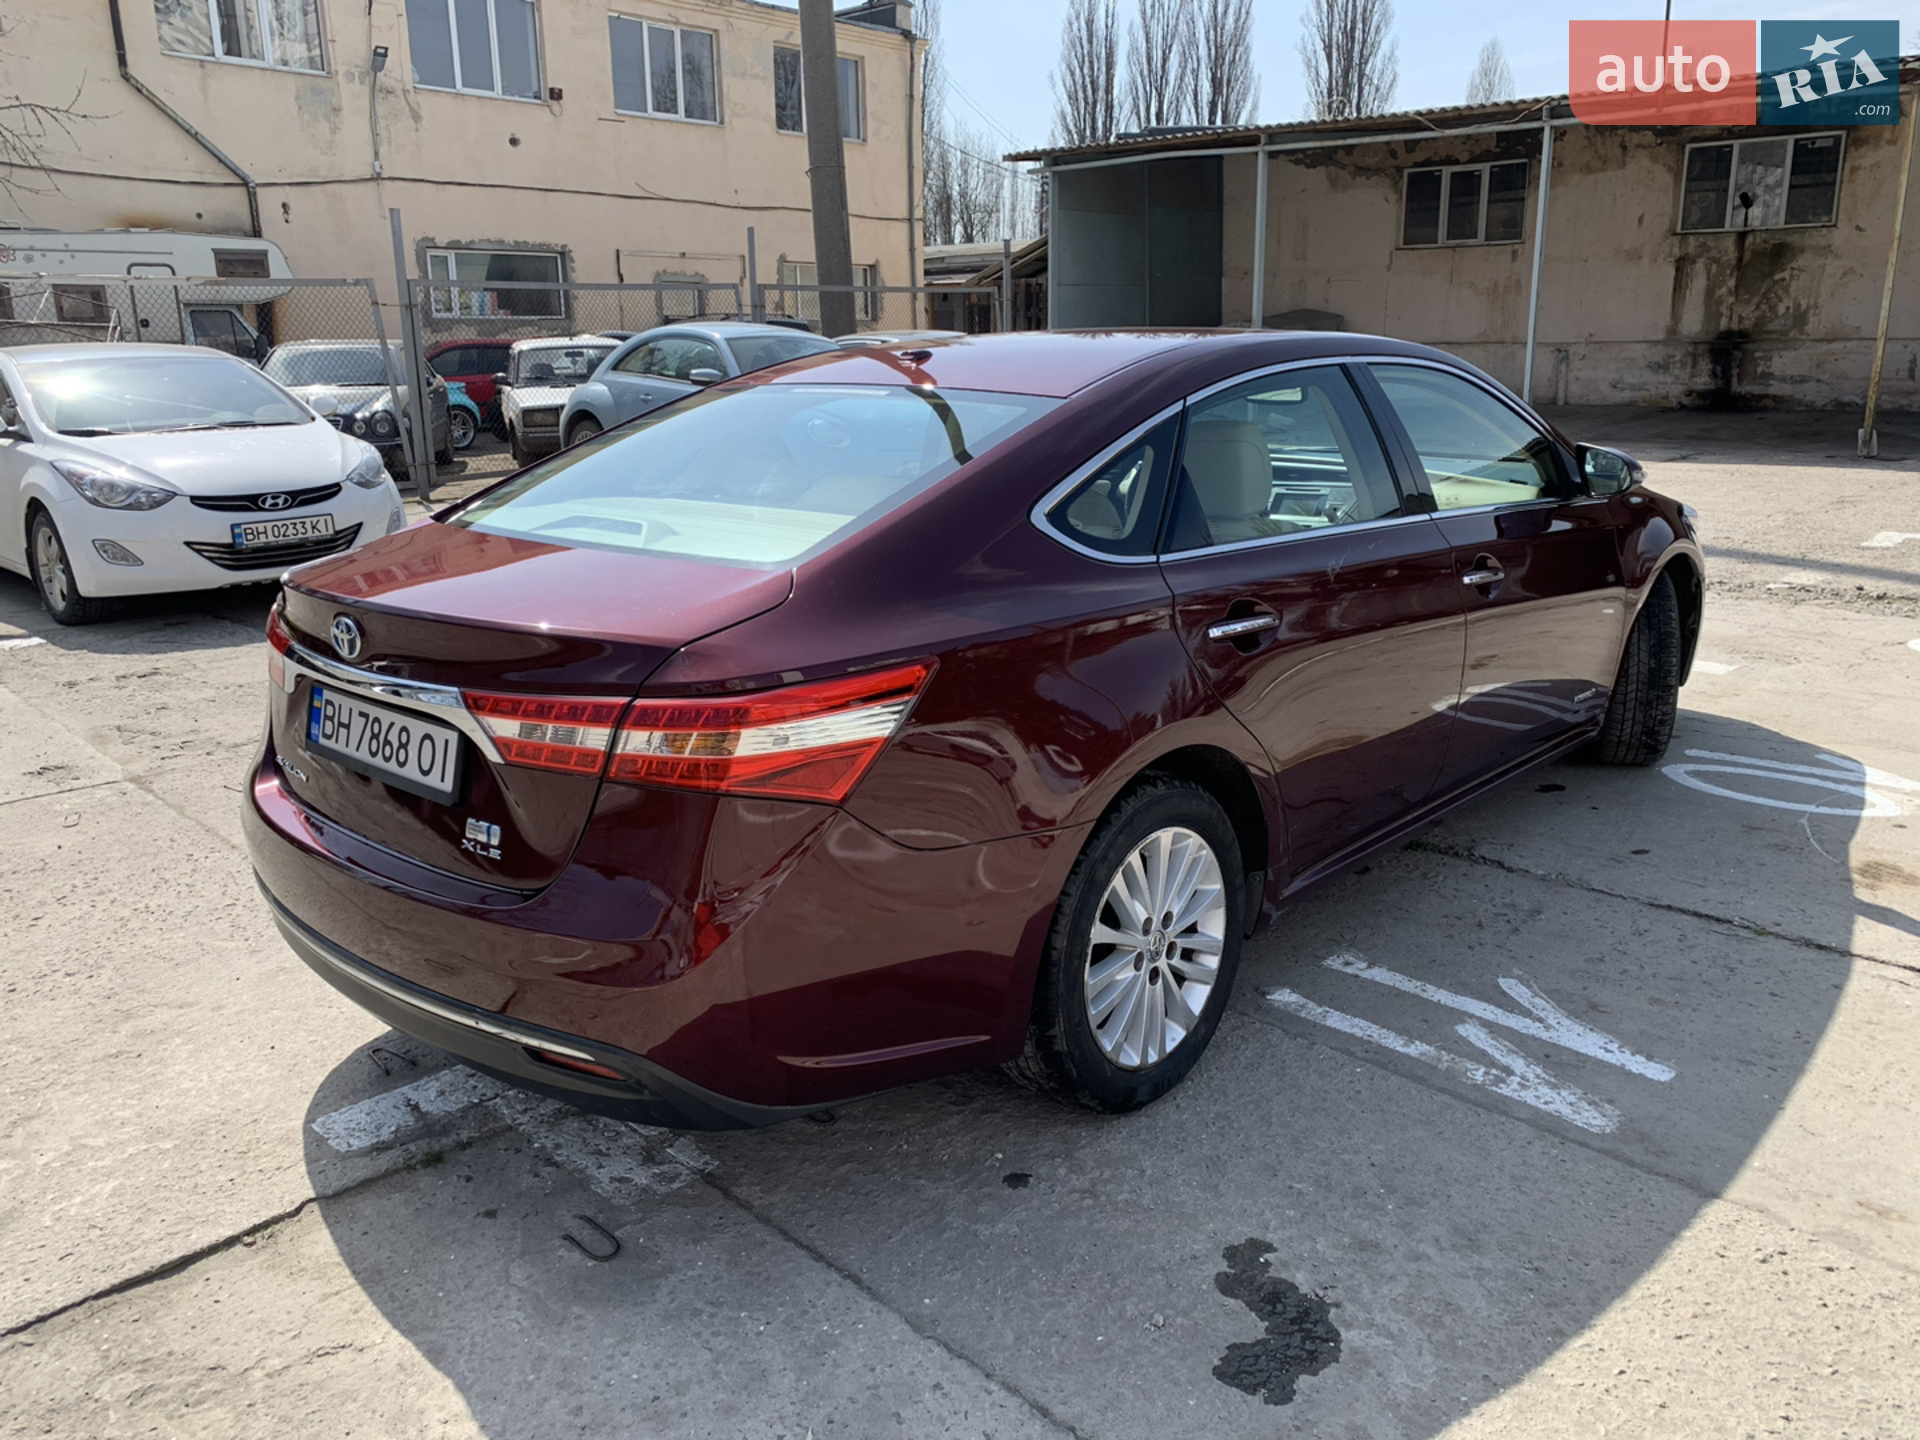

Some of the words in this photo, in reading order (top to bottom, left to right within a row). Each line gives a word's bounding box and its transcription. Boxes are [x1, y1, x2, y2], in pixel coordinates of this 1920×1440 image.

[243, 525, 269, 542] BH
[271, 521, 308, 539] 0233
[310, 518, 329, 535] KI
[321, 698, 353, 748] BH
[355, 710, 411, 769] 7868
[417, 732, 449, 783] OI
[461, 838, 502, 860] XLE
